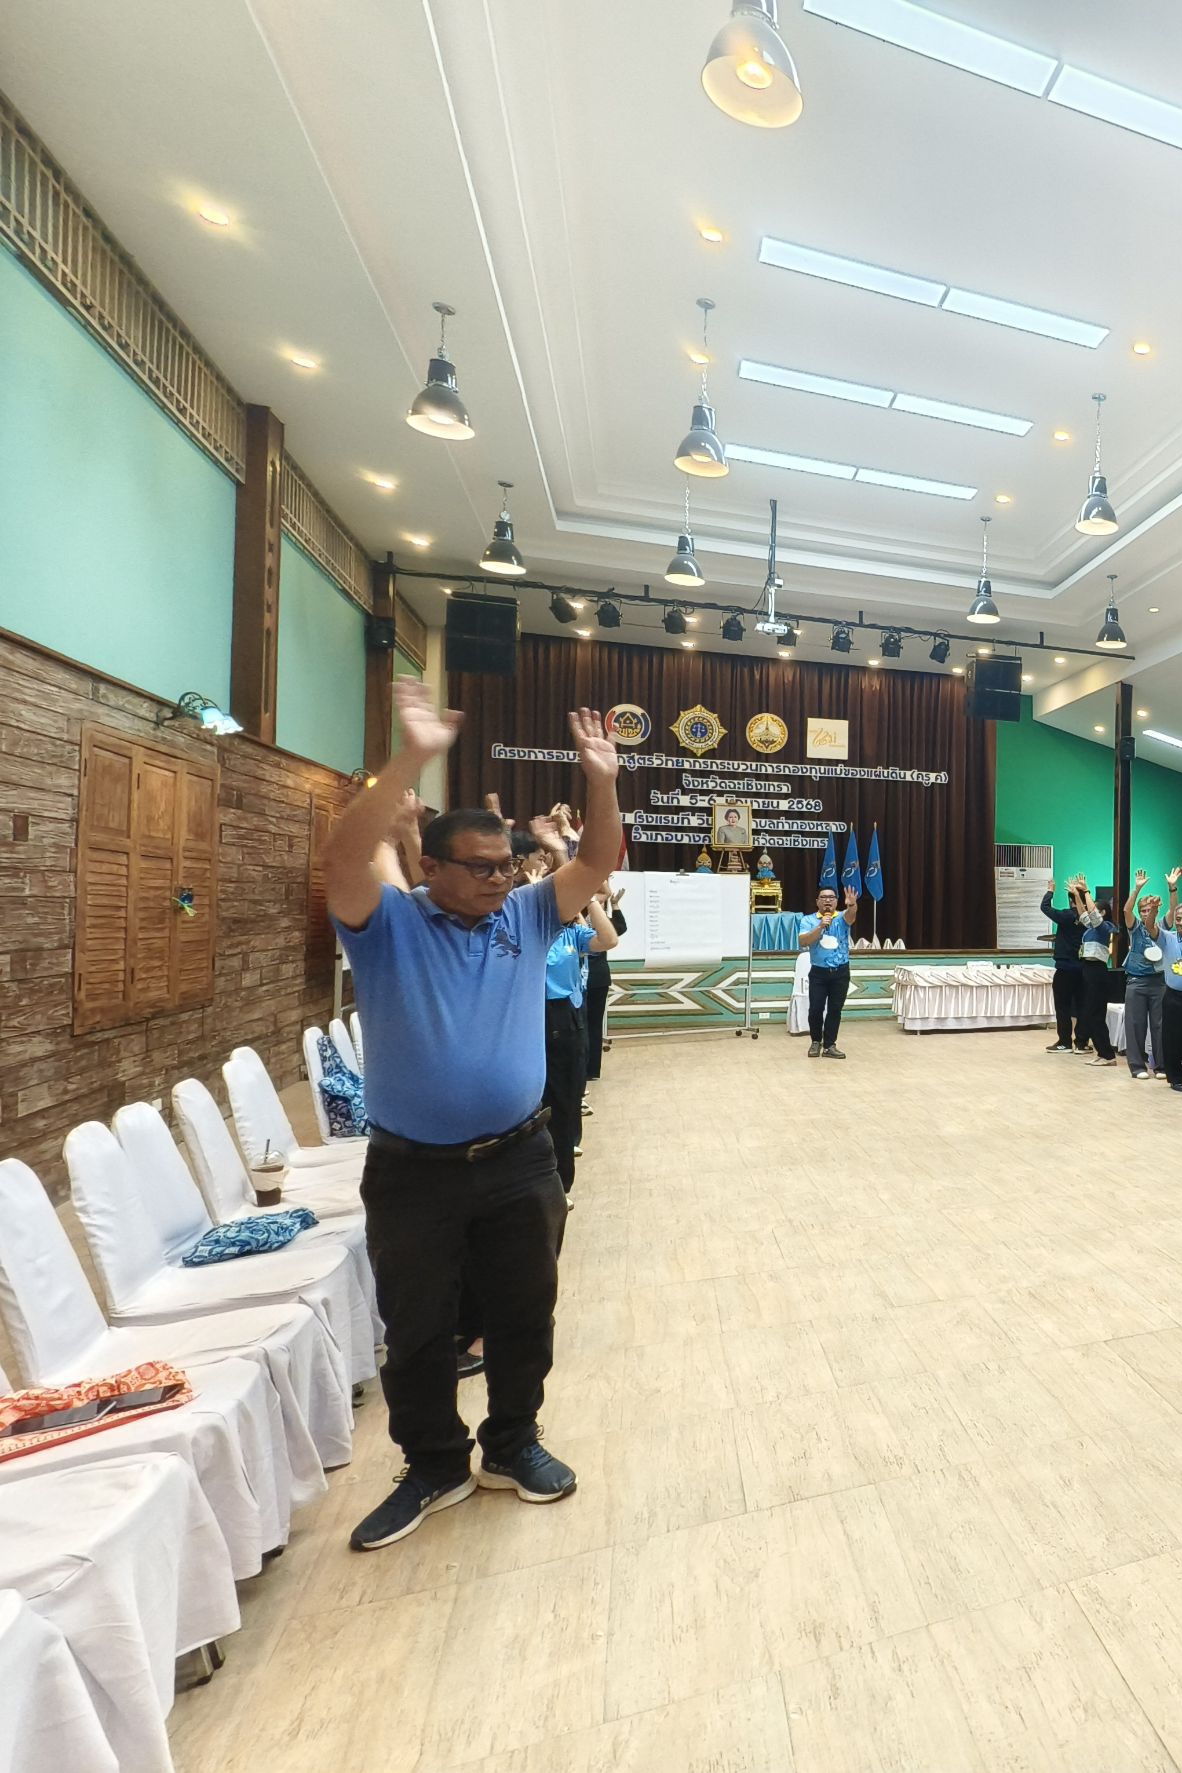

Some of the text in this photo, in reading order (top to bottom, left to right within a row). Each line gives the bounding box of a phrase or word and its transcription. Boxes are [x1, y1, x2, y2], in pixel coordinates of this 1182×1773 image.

[683, 775, 791, 792] จังหวัดฉะเชิงเทรา
[910, 770, 931, 785] (ครู
[934, 773, 948, 783] ค)
[652, 790, 681, 804] วันที่
[688, 794, 717, 806] 5-6
[787, 799, 823, 811] 2568
[633, 827, 712, 843] อำเภอบางค
